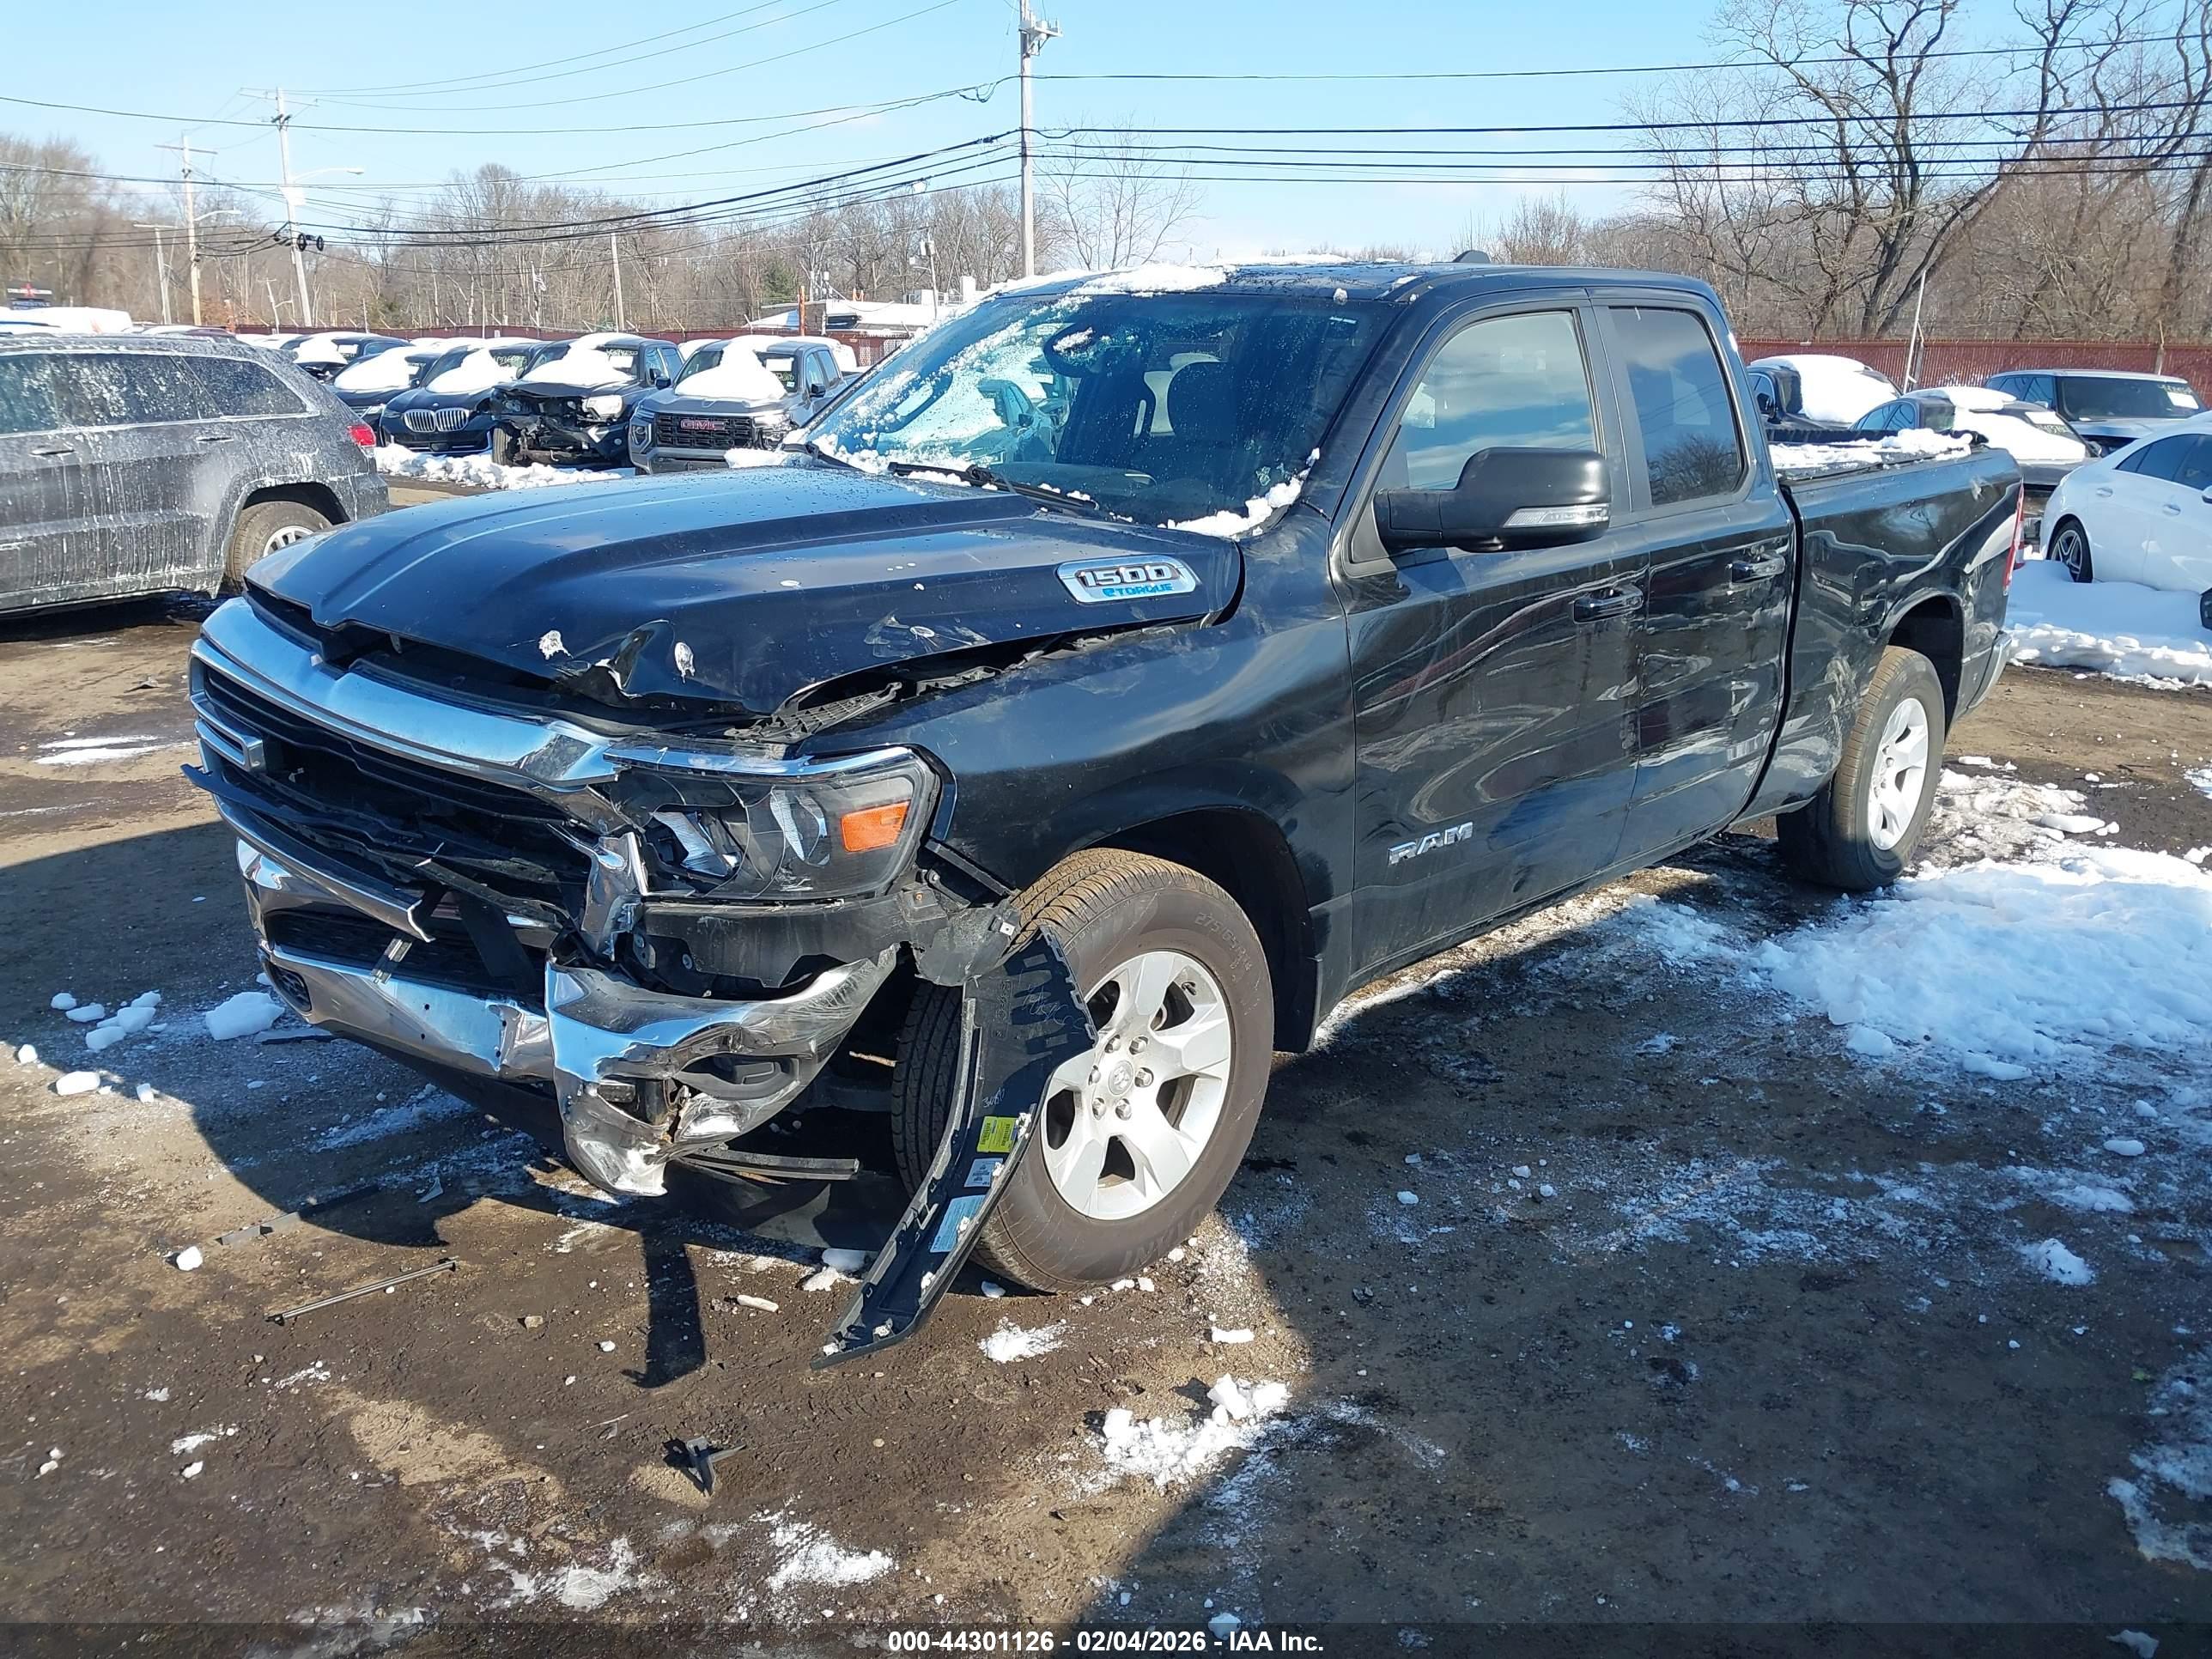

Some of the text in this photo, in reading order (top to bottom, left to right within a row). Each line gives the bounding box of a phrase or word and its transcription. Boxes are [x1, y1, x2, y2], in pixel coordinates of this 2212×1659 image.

[681, 419, 726, 431] GMC
[1079, 564, 1172, 587] 1500
[1388, 822, 1473, 865] RAM
